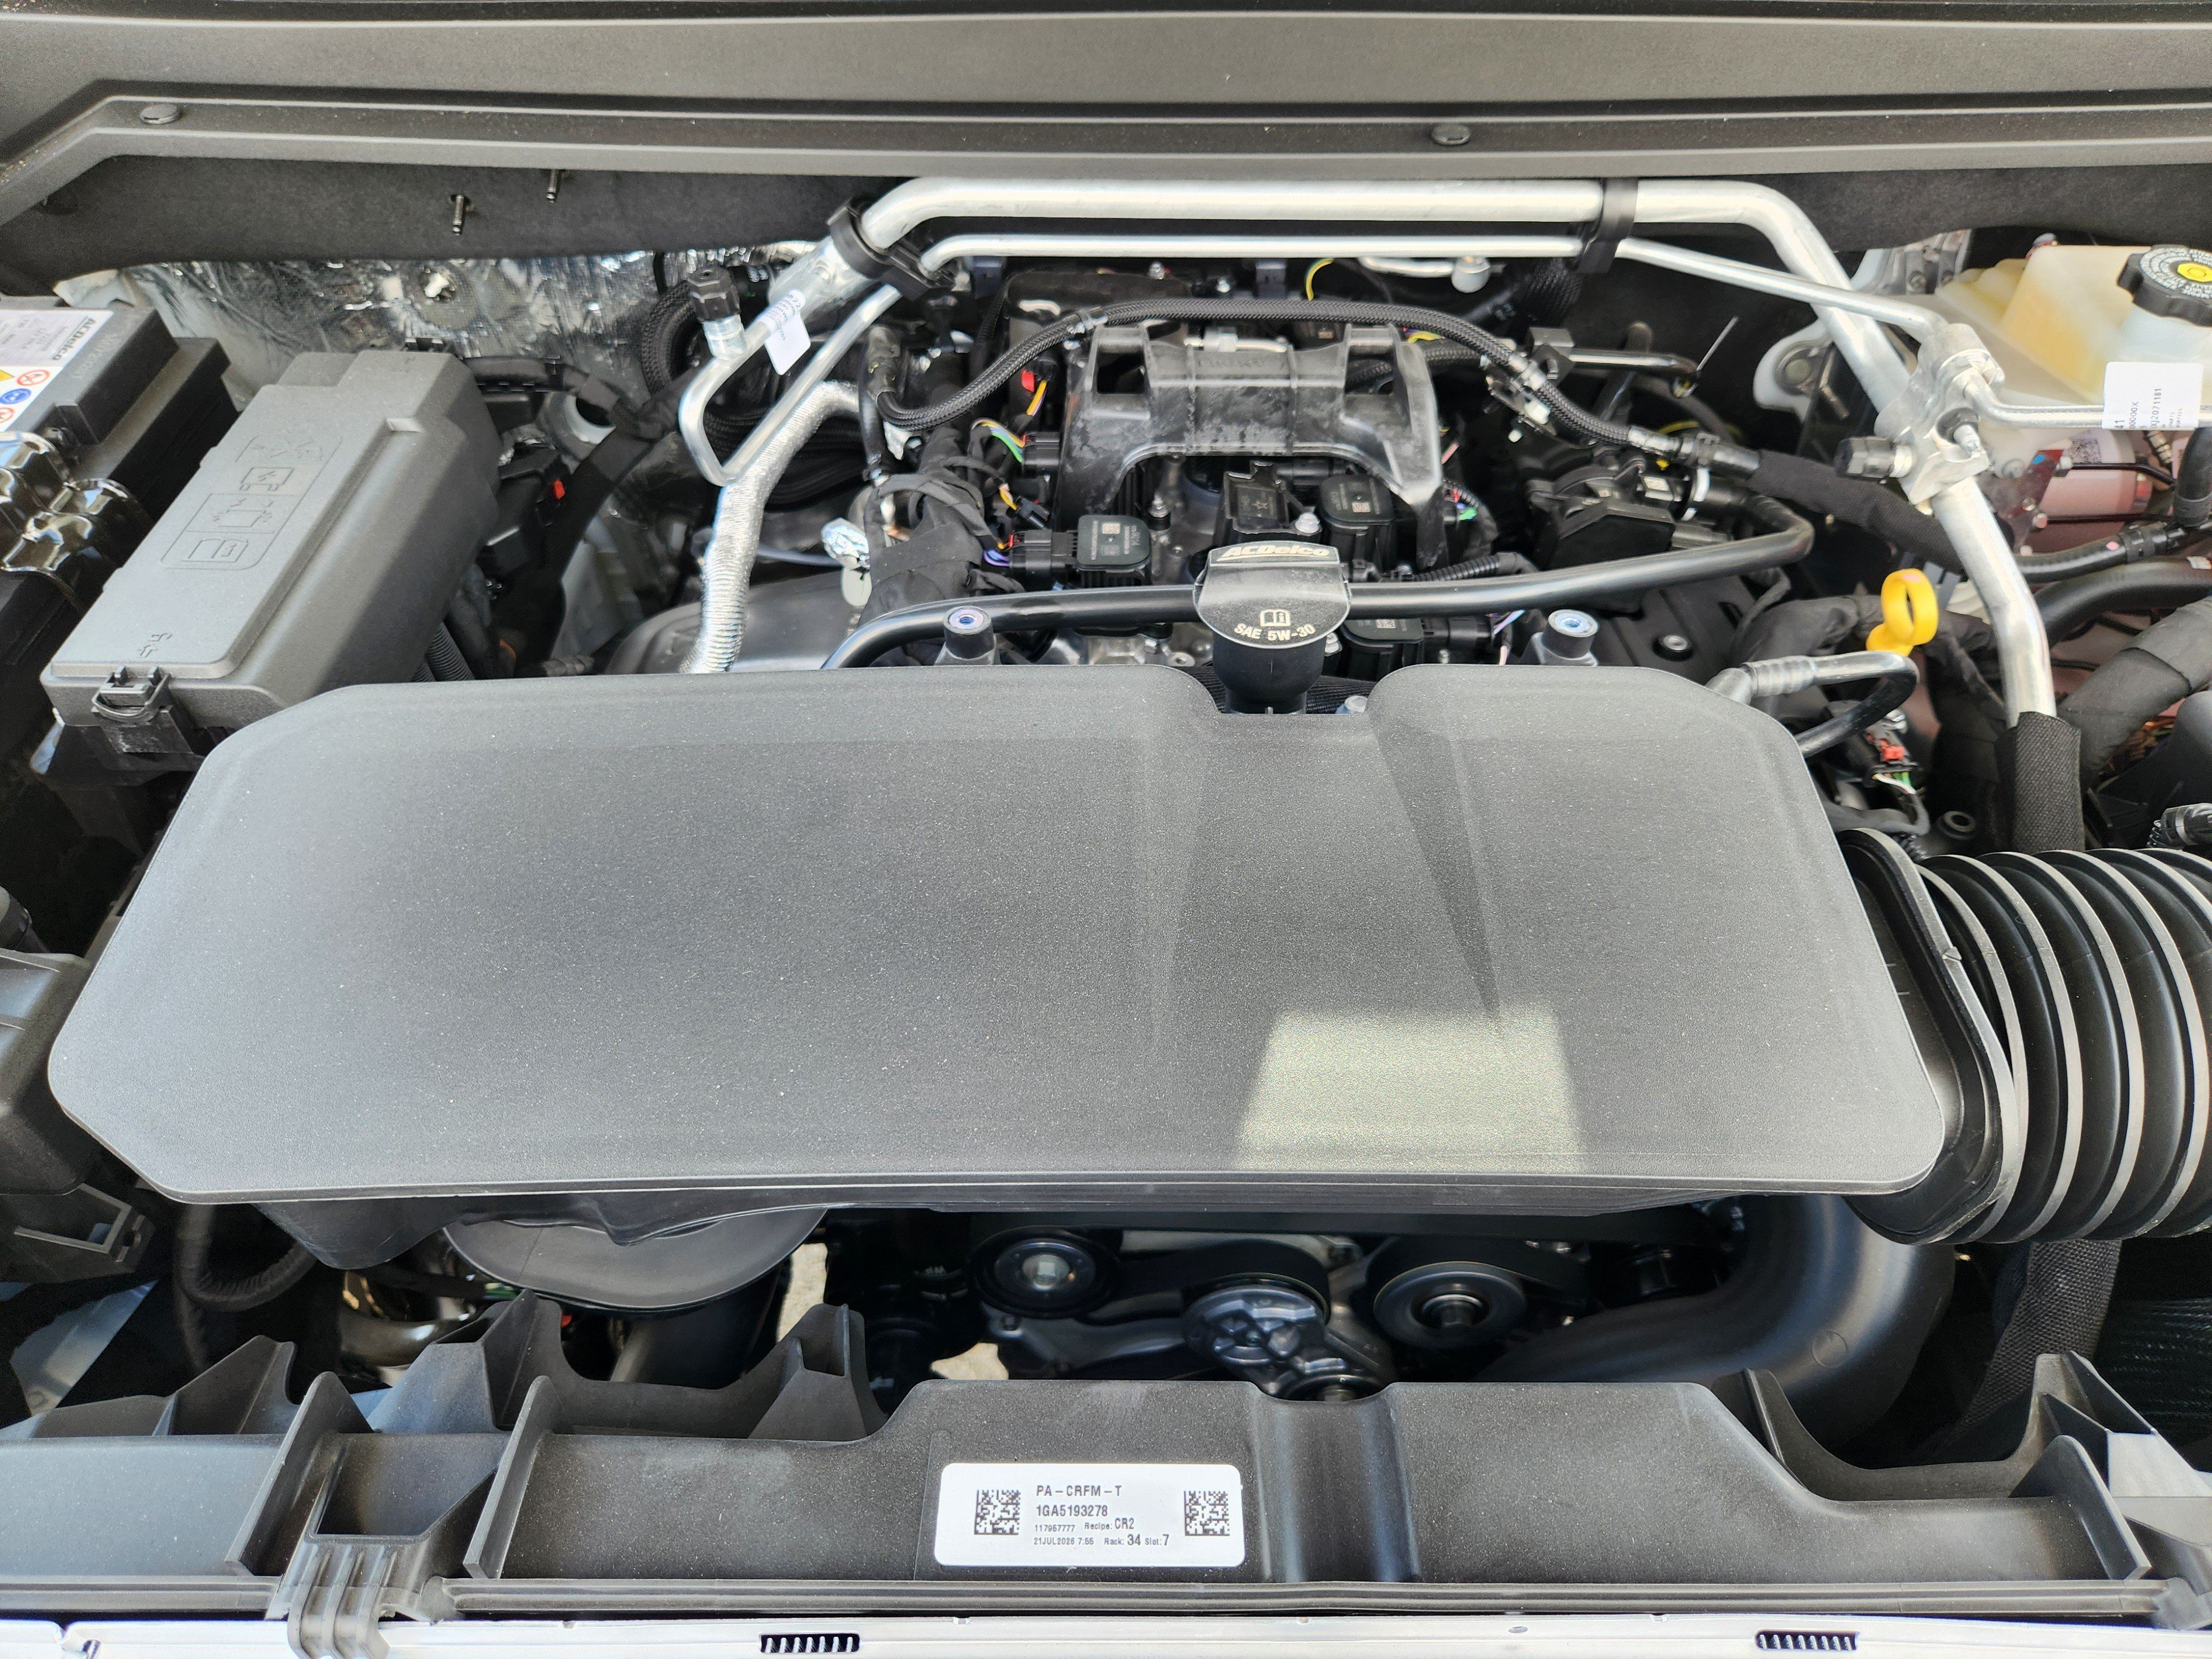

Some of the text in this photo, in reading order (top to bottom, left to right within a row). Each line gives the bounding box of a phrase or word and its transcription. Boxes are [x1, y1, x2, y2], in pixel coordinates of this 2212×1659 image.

[53, 318, 95, 360] ACDelco
[1221, 545, 1330, 557] ACDelco
[1234, 623, 1316, 641] SAE 5W-30
[1036, 1504, 1108, 1517] 1GA5193278
[1084, 1522, 1113, 1531] Recipe:
[1115, 1517, 1134, 1530] CR2
[1034, 1537, 1075, 1545] 21JUL2026
[1104, 1537, 1124, 1545] Rack:
[1127, 1533, 1141, 1546] 34
